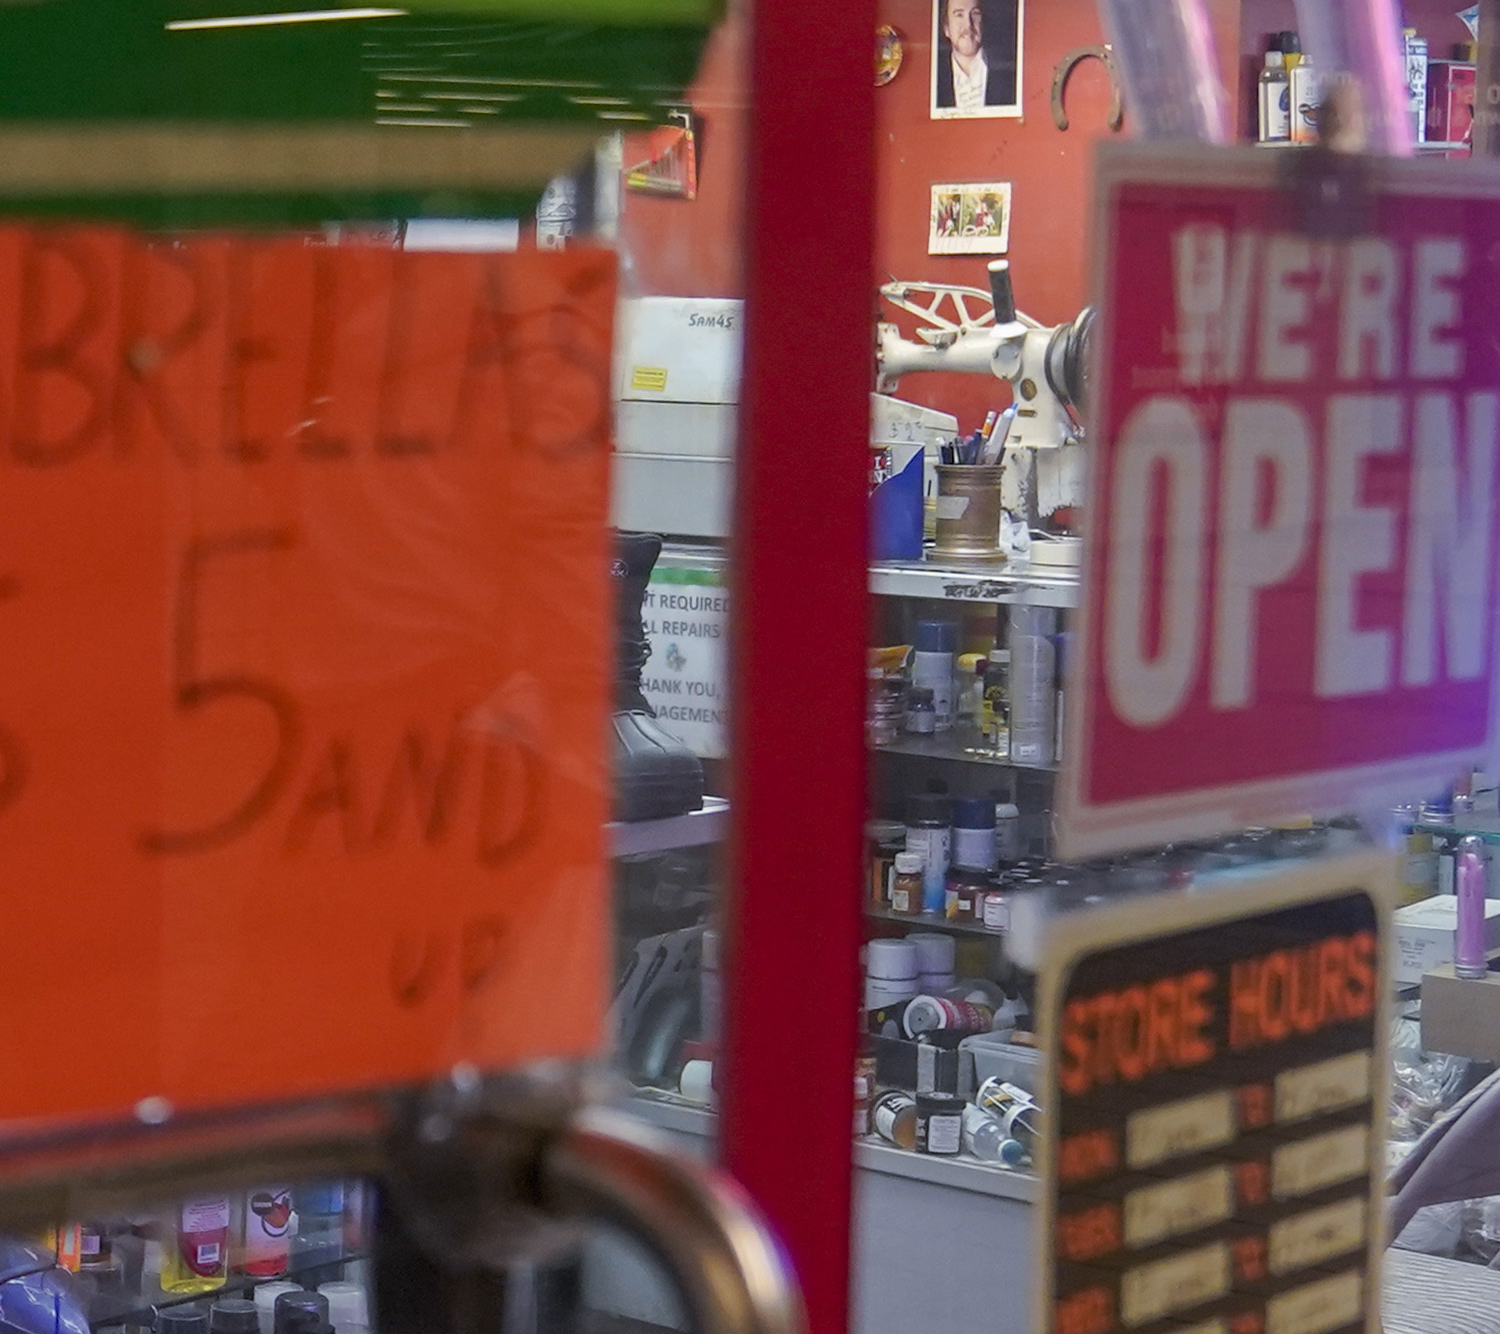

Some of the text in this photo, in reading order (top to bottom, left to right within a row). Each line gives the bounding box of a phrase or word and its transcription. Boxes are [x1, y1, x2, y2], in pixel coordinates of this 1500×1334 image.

[1172, 223, 1467, 389] WE'RE
[662, 620, 720, 639] REPAIRS
[1107, 388, 1495, 729] OPEN
[133, 524, 300, 854] 5
[641, 677, 682, 695] HANK
[1061, 932, 1378, 1096] STORE HOURS
